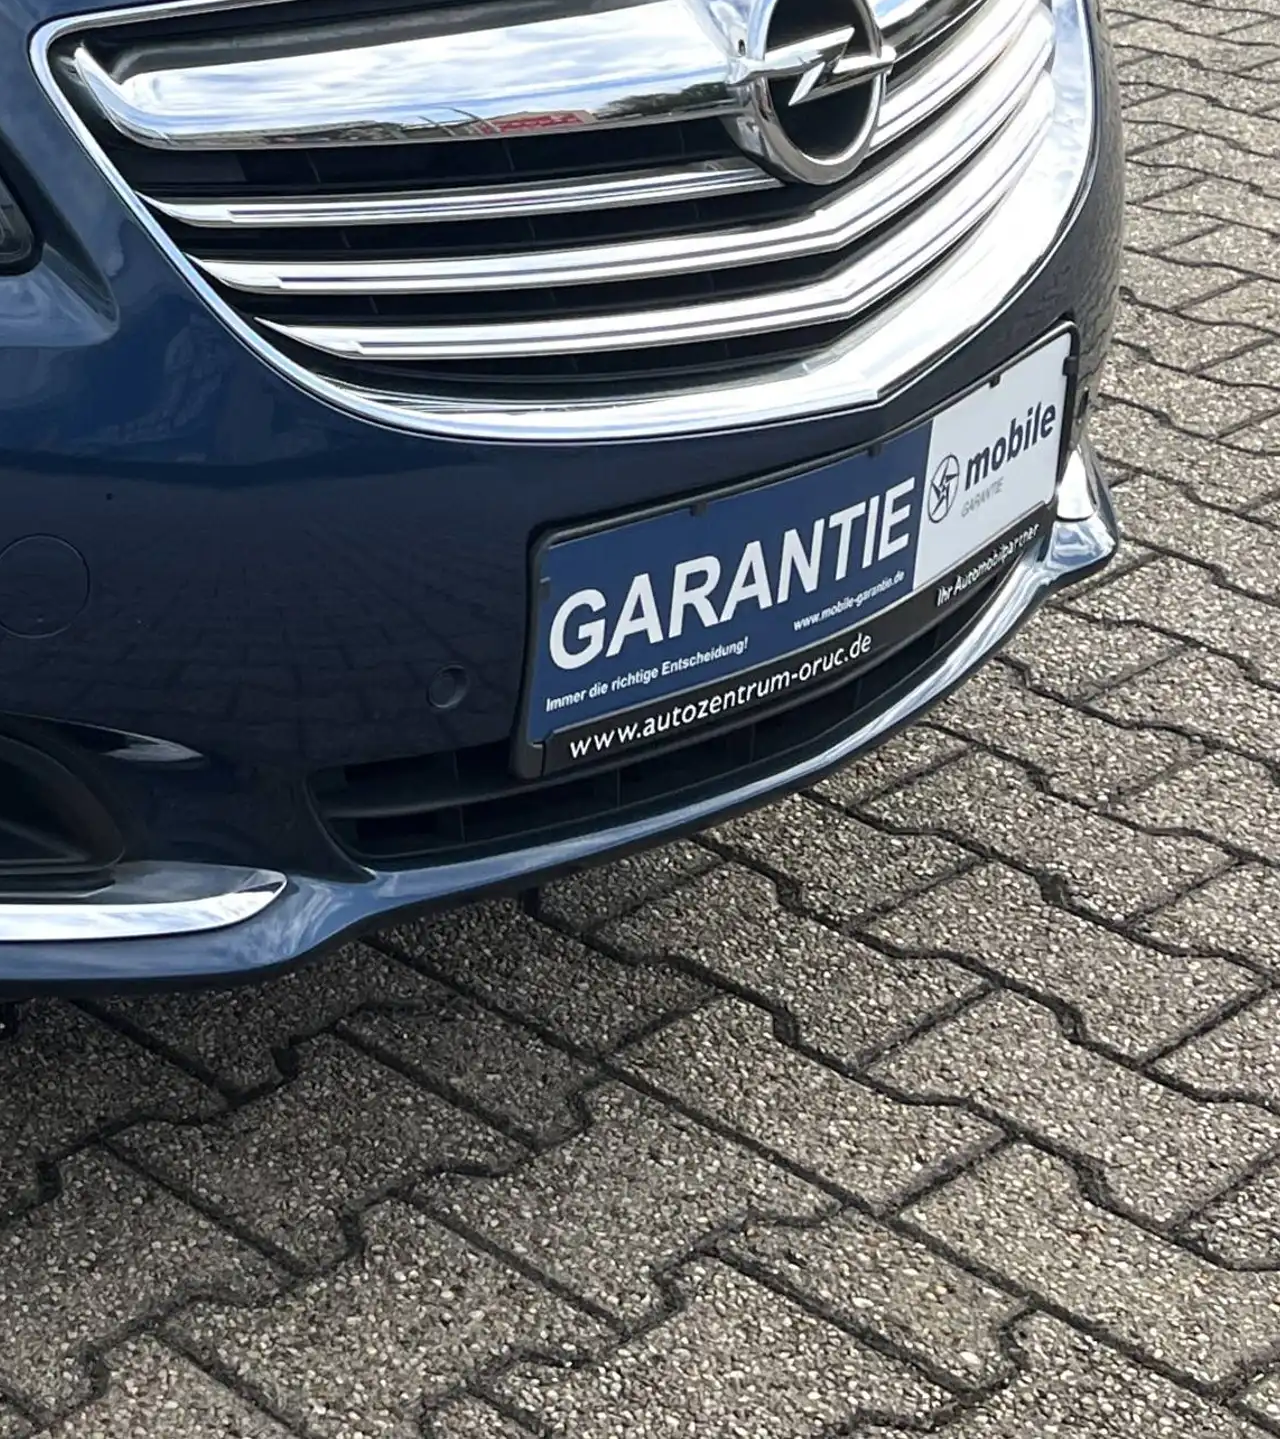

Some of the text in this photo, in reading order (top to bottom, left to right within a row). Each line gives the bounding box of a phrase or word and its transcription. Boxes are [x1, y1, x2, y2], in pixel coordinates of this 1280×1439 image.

[964, 400, 1057, 492] mobile
[549, 476, 917, 671] GARANTIE
[546, 636, 750, 712] Immer die richtige Entscheidung!
[569, 631, 872, 760] www.autozentrum-oruc.de
